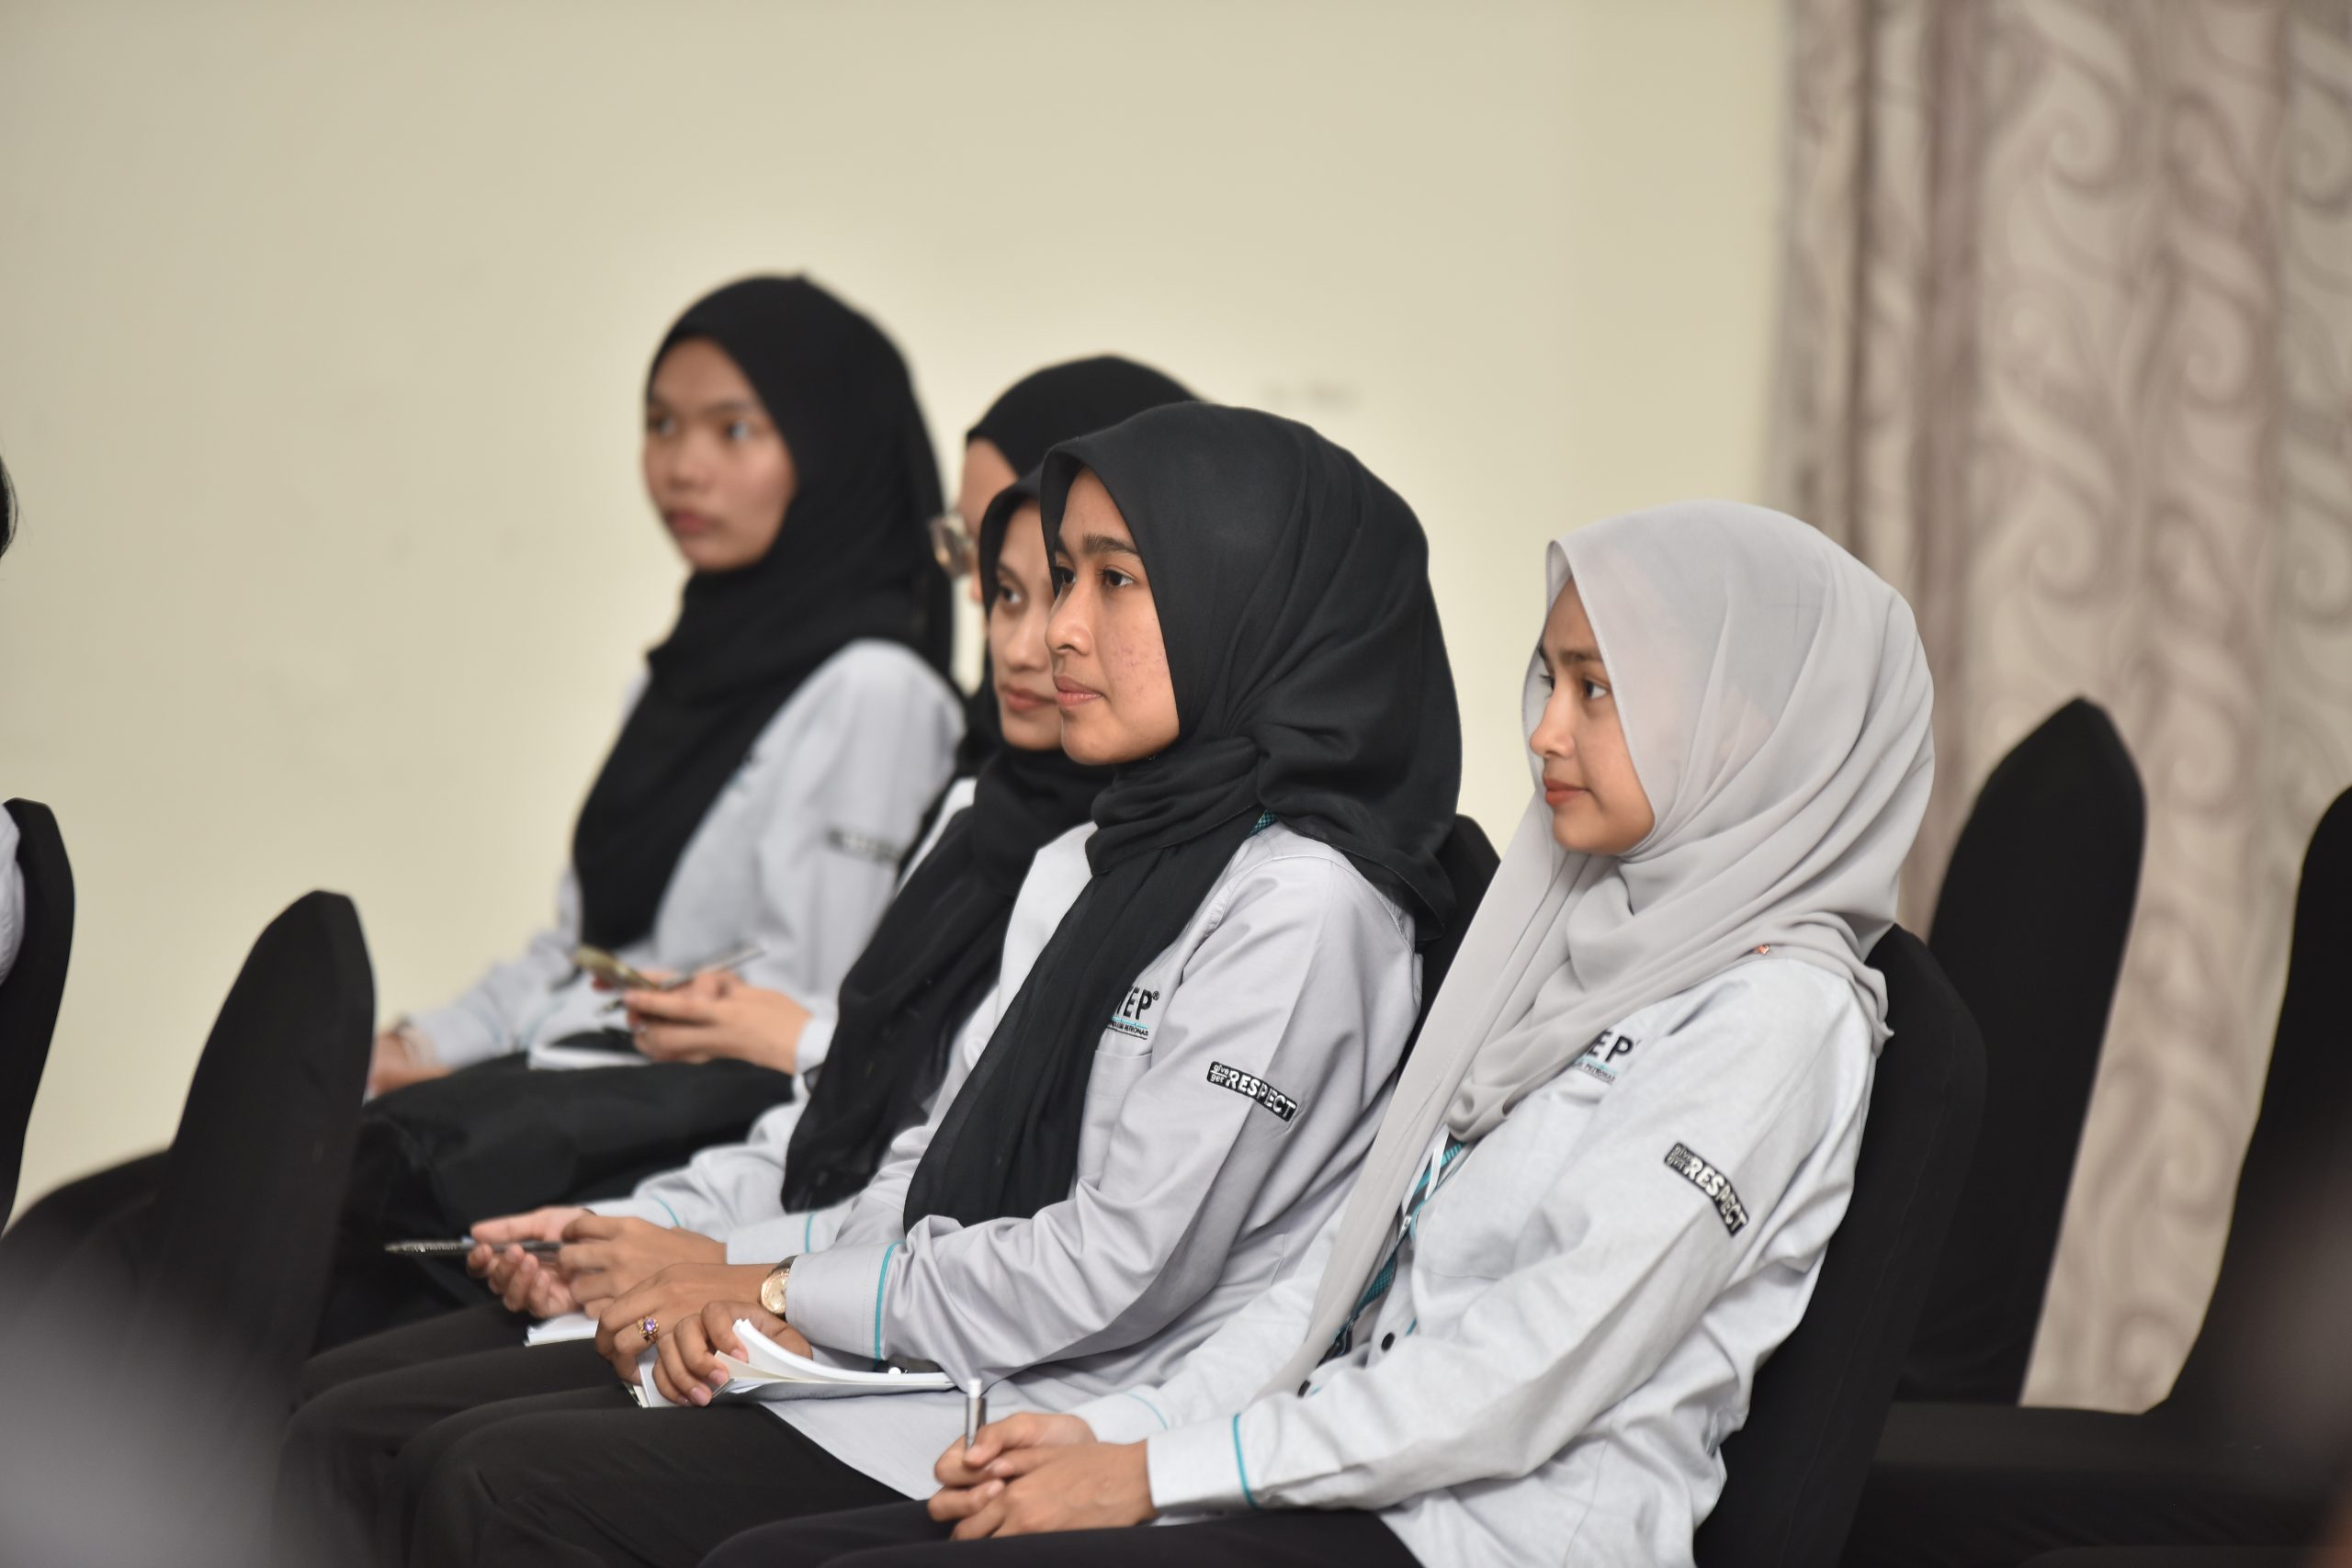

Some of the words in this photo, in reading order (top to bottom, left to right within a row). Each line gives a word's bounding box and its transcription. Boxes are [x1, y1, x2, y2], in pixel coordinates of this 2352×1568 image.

[1211, 1073, 1225, 1083] get
[1213, 1064, 1229, 1075] give
[1226, 1070, 1296, 1117] RESPECT
[1683, 1156, 1747, 1231] RESPECT
